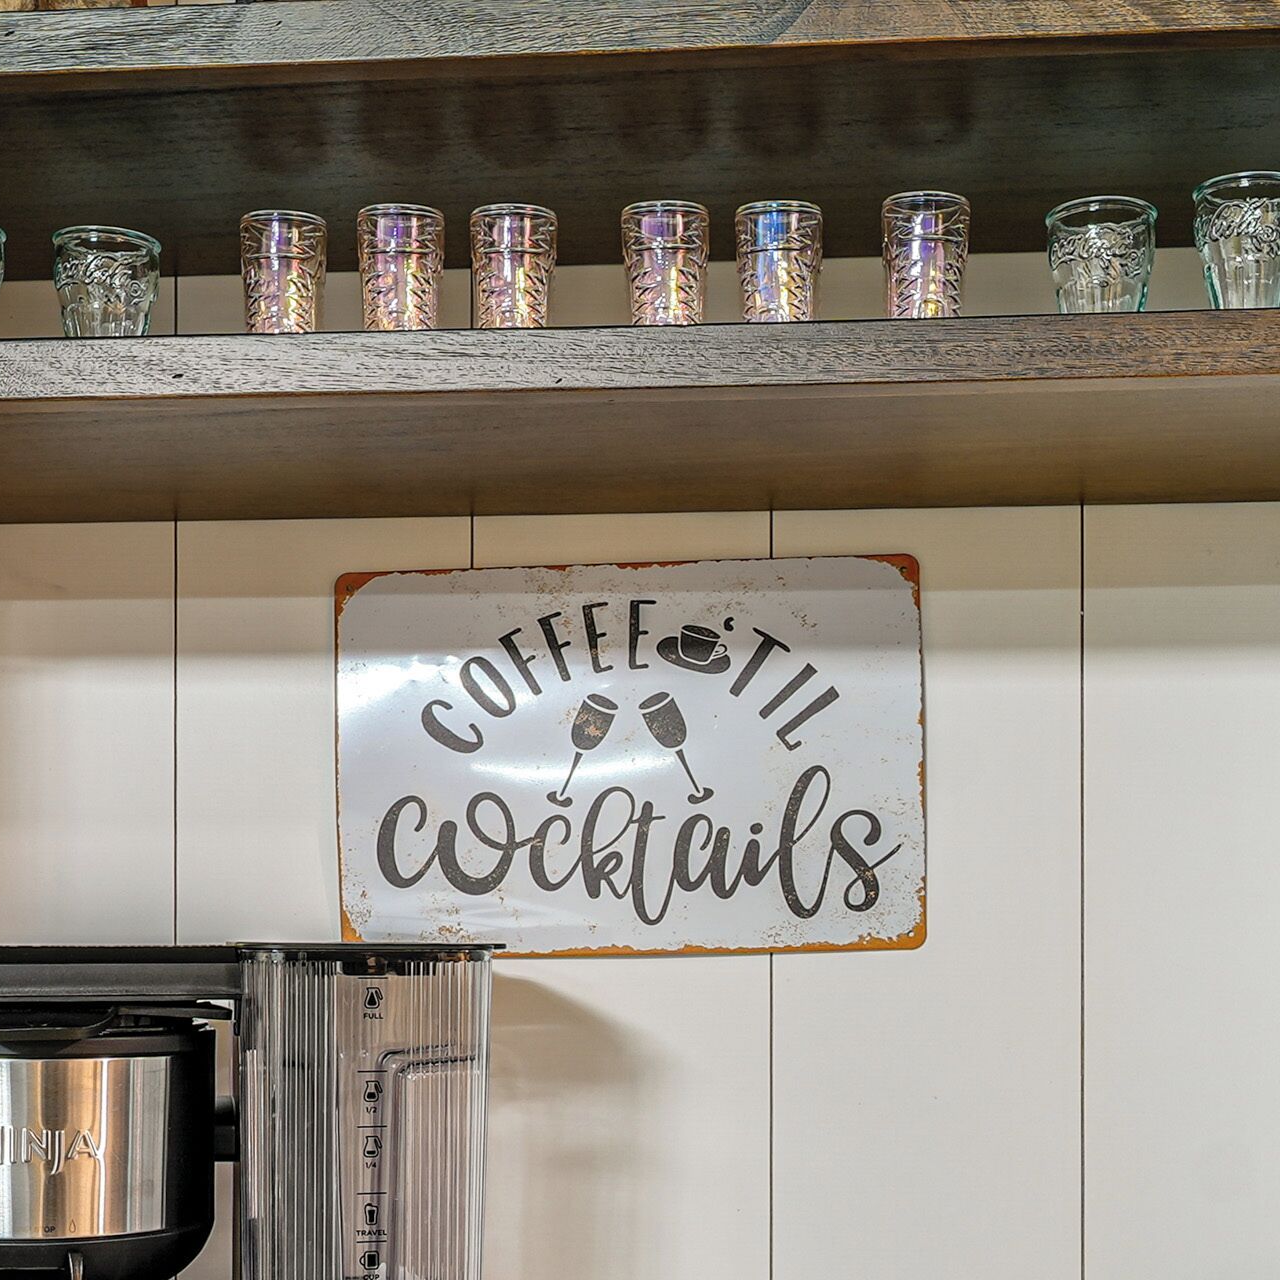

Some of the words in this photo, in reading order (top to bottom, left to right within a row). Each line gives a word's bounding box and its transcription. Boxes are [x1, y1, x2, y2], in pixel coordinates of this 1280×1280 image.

[421, 600, 657, 754] COFFEE
[363, 1012, 384, 1020] FULL
[365, 1106, 378, 1114] 1/2
[365, 1161, 377, 1169] 1/4
